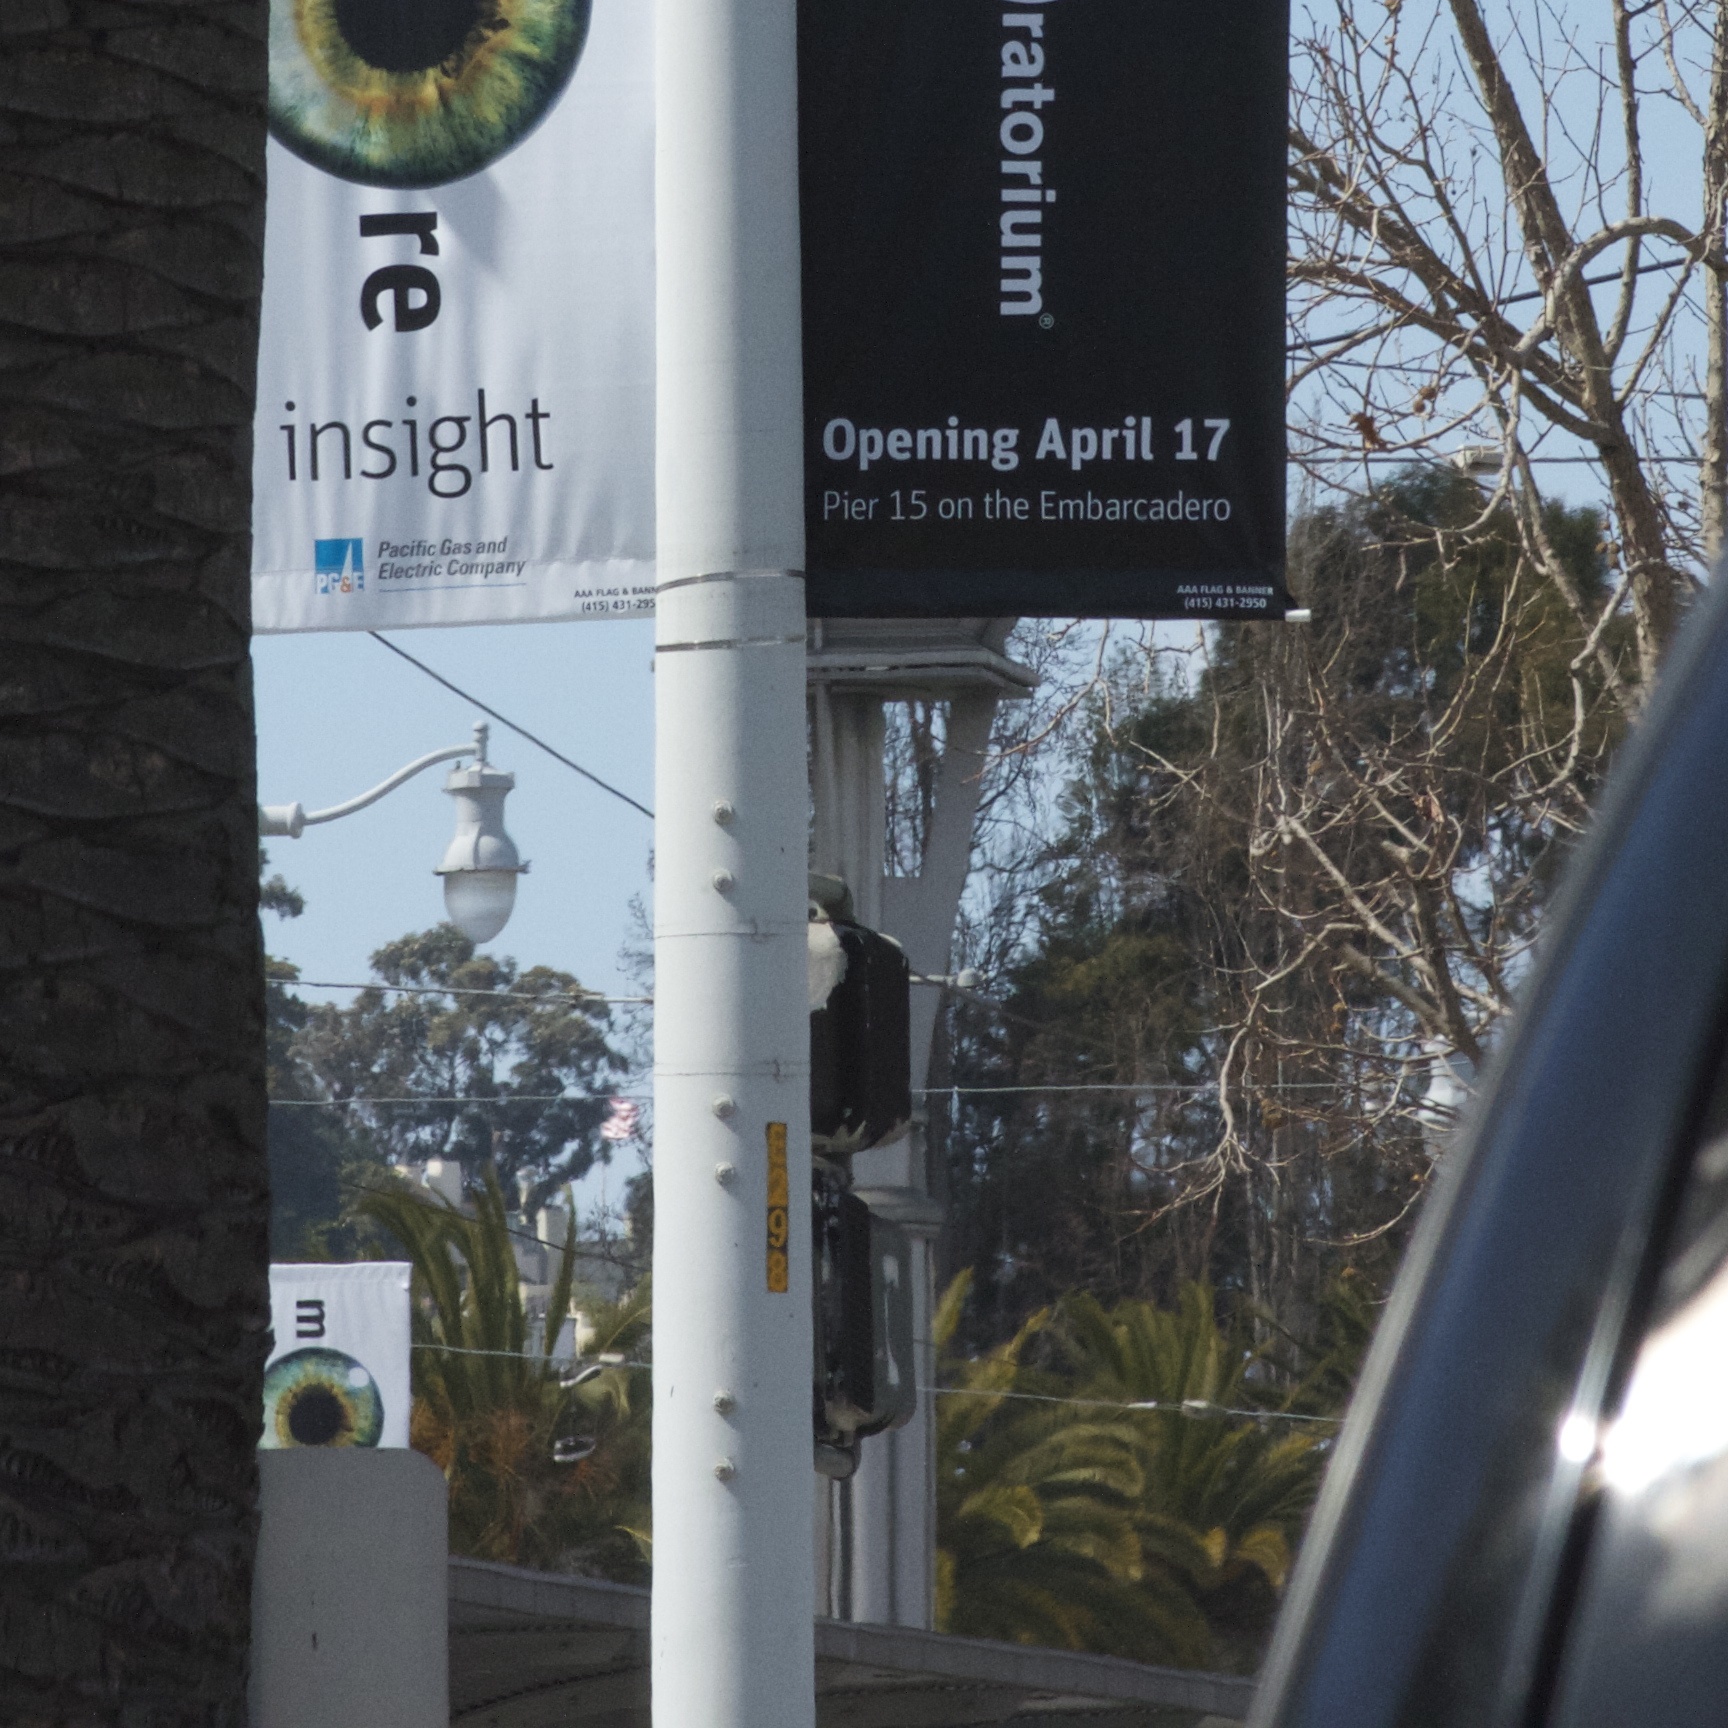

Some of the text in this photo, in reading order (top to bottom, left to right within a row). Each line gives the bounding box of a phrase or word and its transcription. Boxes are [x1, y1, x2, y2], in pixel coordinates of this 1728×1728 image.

[279, 387, 555, 499] insight
[822, 415, 1232, 471] Opening April 17
[823, 488, 1232, 522] Pier 15 on the Embarcadero
[377, 537, 508, 559] Pacific Gas and
[377, 559, 527, 580] Electric Company
[315, 571, 364, 594] PG&E
[574, 590, 593, 598] AAA
[596, 588, 620, 597] FLAG
[1176, 585, 1274, 595] AAA FLAG & BANNER
[581, 600, 609, 613] (415)
[1184, 596, 1267, 610] (415) 431-2950
